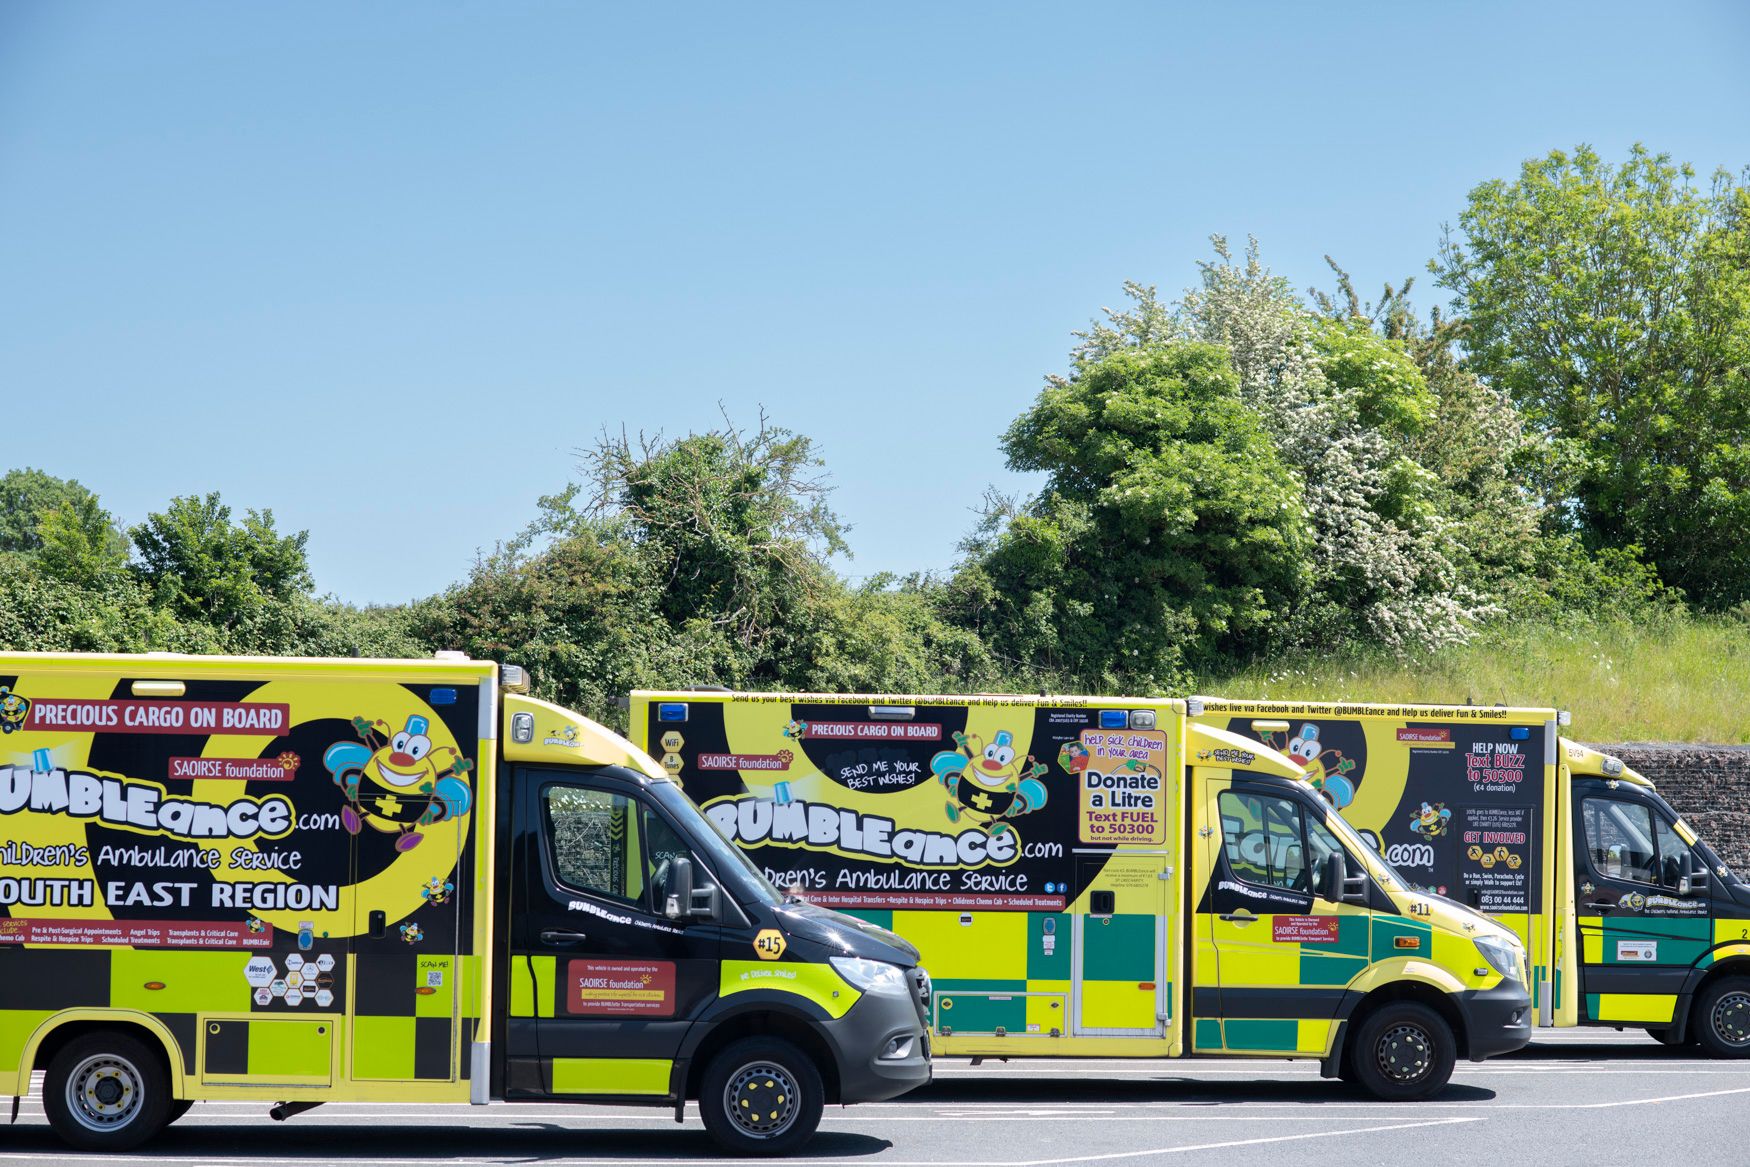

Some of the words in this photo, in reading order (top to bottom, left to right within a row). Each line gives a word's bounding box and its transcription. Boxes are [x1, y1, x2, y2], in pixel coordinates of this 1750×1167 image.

[732, 694, 748, 702] Send
[762, 696, 777, 704] your
[780, 695, 796, 703] best
[798, 696, 823, 704] wishes
[825, 696, 836, 704] via
[838, 696, 870, 704] Facebook
[872, 696, 885, 704] and
[888, 696, 912, 705] Twitter
[982, 698, 998, 708] Help
[1011, 698, 1035, 707] deliver
[1036, 699, 1049, 707] Fun
[1060, 699, 1088, 708] Smiles!!
[34, 703, 117, 726] PRECIOUS
[123, 705, 183, 728] CARGO
[188, 706, 216, 728] ON
[221, 707, 283, 730] BOARD
[1203, 703, 1228, 712] wishes
[1229, 703, 1242, 712] live
[1244, 704, 1255, 712] via
[1256, 704, 1289, 713] Facebook
[1291, 704, 1304, 714] and
[1307, 704, 1332, 714] Twitter
[1334, 706, 1384, 716] @BUMBLEance
[1387, 708, 1400, 716] and
[1402, 708, 1418, 718] Help
[1430, 709, 1454, 718] deliver
[1456, 709, 1468, 718] Fun
[1471, 710, 1477, 718] &
[1479, 710, 1507, 719] Smiles!!
[812, 724, 854, 736] PRECIOUS
[857, 724, 888, 737] CARGO
[890, 725, 904, 737] ON
[906, 726, 938, 738] BOARD
[664, 738, 680, 747] WiFi
[1085, 734, 1104, 746] help
[1108, 734, 1124, 746] sick
[1128, 736, 1162, 750] children
[1472, 742, 1494, 754] HELP
[1495, 743, 1518, 754] NOW
[1097, 746, 1105, 756] in
[1108, 748, 1126, 760] your
[1128, 750, 1148, 760] area
[664, 762, 680, 770] Tunes
[702, 756, 737, 768] SAOIRSE
[739, 756, 782, 770] foundation
[1465, 754, 1490, 768] Text
[1494, 754, 1525, 768] BUZZ
[173, 759, 222, 776] SAOIRSE
[224, 762, 284, 778] foundation
[840, 764, 868, 779] SEND
[872, 762, 889, 773] ME
[892, 761, 921, 773] YOUR
[1467, 768, 1480, 782] to
[1482, 769, 1523, 783] 50300
[847, 776, 876, 790] BEST
[878, 773, 915, 785] WISHES!
[1086, 771, 1159, 790] Donate
[1474, 783, 1485, 792] (€4
[1486, 784, 1516, 794] donation)
[1092, 794, 1103, 808] a
[1110, 790, 1153, 808] Litre
[295, 813, 340, 831] .com
[1086, 811, 1118, 822] Text
[1120, 812, 1158, 823] FUEL
[704, 799, 1018, 866] BUMBLEance
[1021, 842, 1063, 858] .com
[1090, 824, 1105, 834] to
[1108, 824, 1155, 835] 50300
[1464, 832, 1480, 843] GET
[1482, 832, 1526, 844] INVOLVED
[97, 845, 221, 869] Ambulance
[228, 847, 302, 870] Service
[836, 870, 951, 891] Ambulance
[960, 871, 1028, 892] Service
[107, 881, 198, 907] EAST
[211, 884, 339, 910] REGION
[1218, 880, 1268, 899] BUMBLEance
[841, 896, 862, 904] Hospital
[914, 897, 934, 906] Hospice
[935, 897, 946, 906] Trips
[952, 897, 975, 905] Childrens
[1008, 898, 1034, 906] Scheduled
[1034, 898, 1062, 906] Treatments
[1481, 895, 1493, 904] 083
[568, 900, 632, 925] BUMBLEance
[1410, 902, 1431, 917] #11
[84, 928, 122, 936] Appointments
[147, 928, 160, 936] Trips
[1274, 926, 1298, 935] SAOIRSE
[1742, 928, 1748, 940] 2
[756, 936, 782, 955] #15
[580, 978, 608, 988] SAOIRSE
[610, 980, 644, 989] foundation
